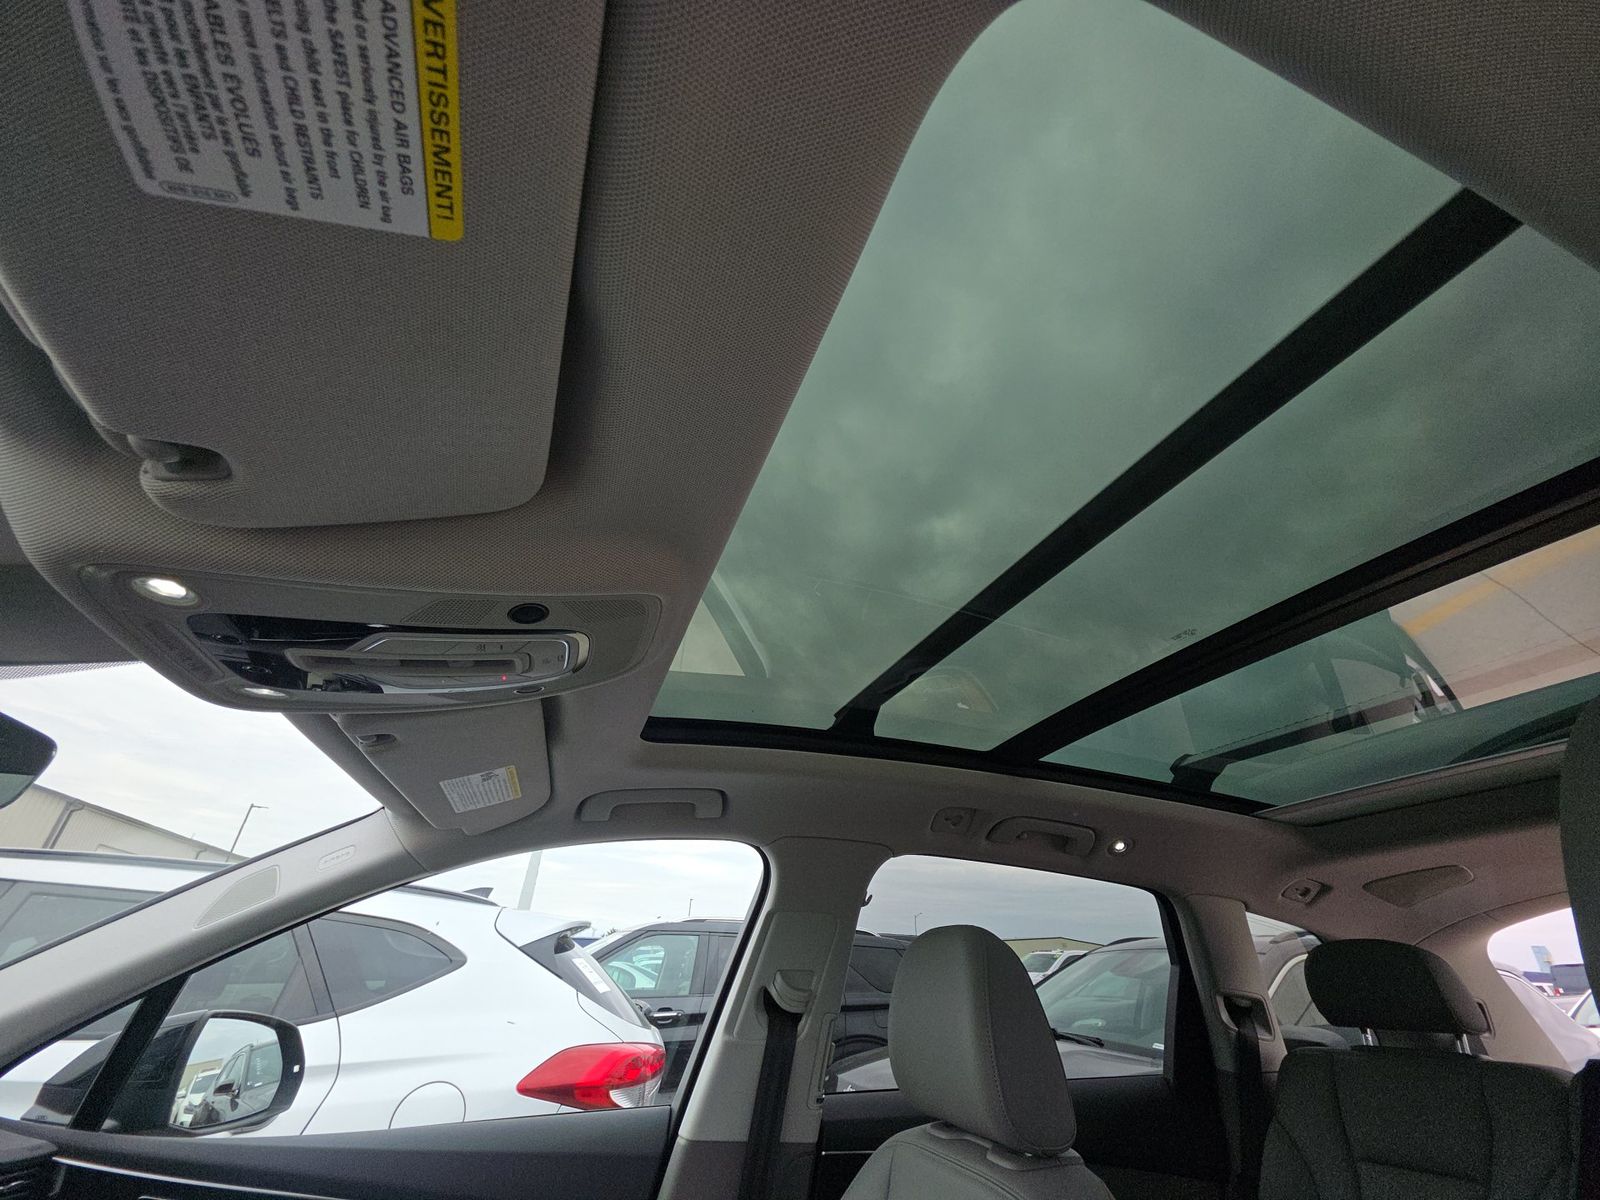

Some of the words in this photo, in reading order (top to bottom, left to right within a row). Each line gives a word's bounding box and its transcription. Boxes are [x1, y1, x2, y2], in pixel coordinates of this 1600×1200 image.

[302, 38, 322, 76] child
[328, 28, 352, 88] SAFEST
[358, 45, 378, 105] seriously
[381, 0, 406, 114] ADVANCED
[282, 75, 307, 119] CHILD
[311, 78, 328, 108] seat
[336, 91, 354, 127] place
[346, 129, 360, 147] for
[367, 108, 386, 151] injured
[394, 118, 410, 149] AIR
[293, 121, 324, 200] RESTRAINTS
[325, 150, 341, 180] front
[373, 153, 386, 167] by
[376, 170, 389, 188] the
[397, 153, 415, 196] BAGS
[350, 151, 371, 209] CHILDREN
[381, 205, 393, 223] bag
